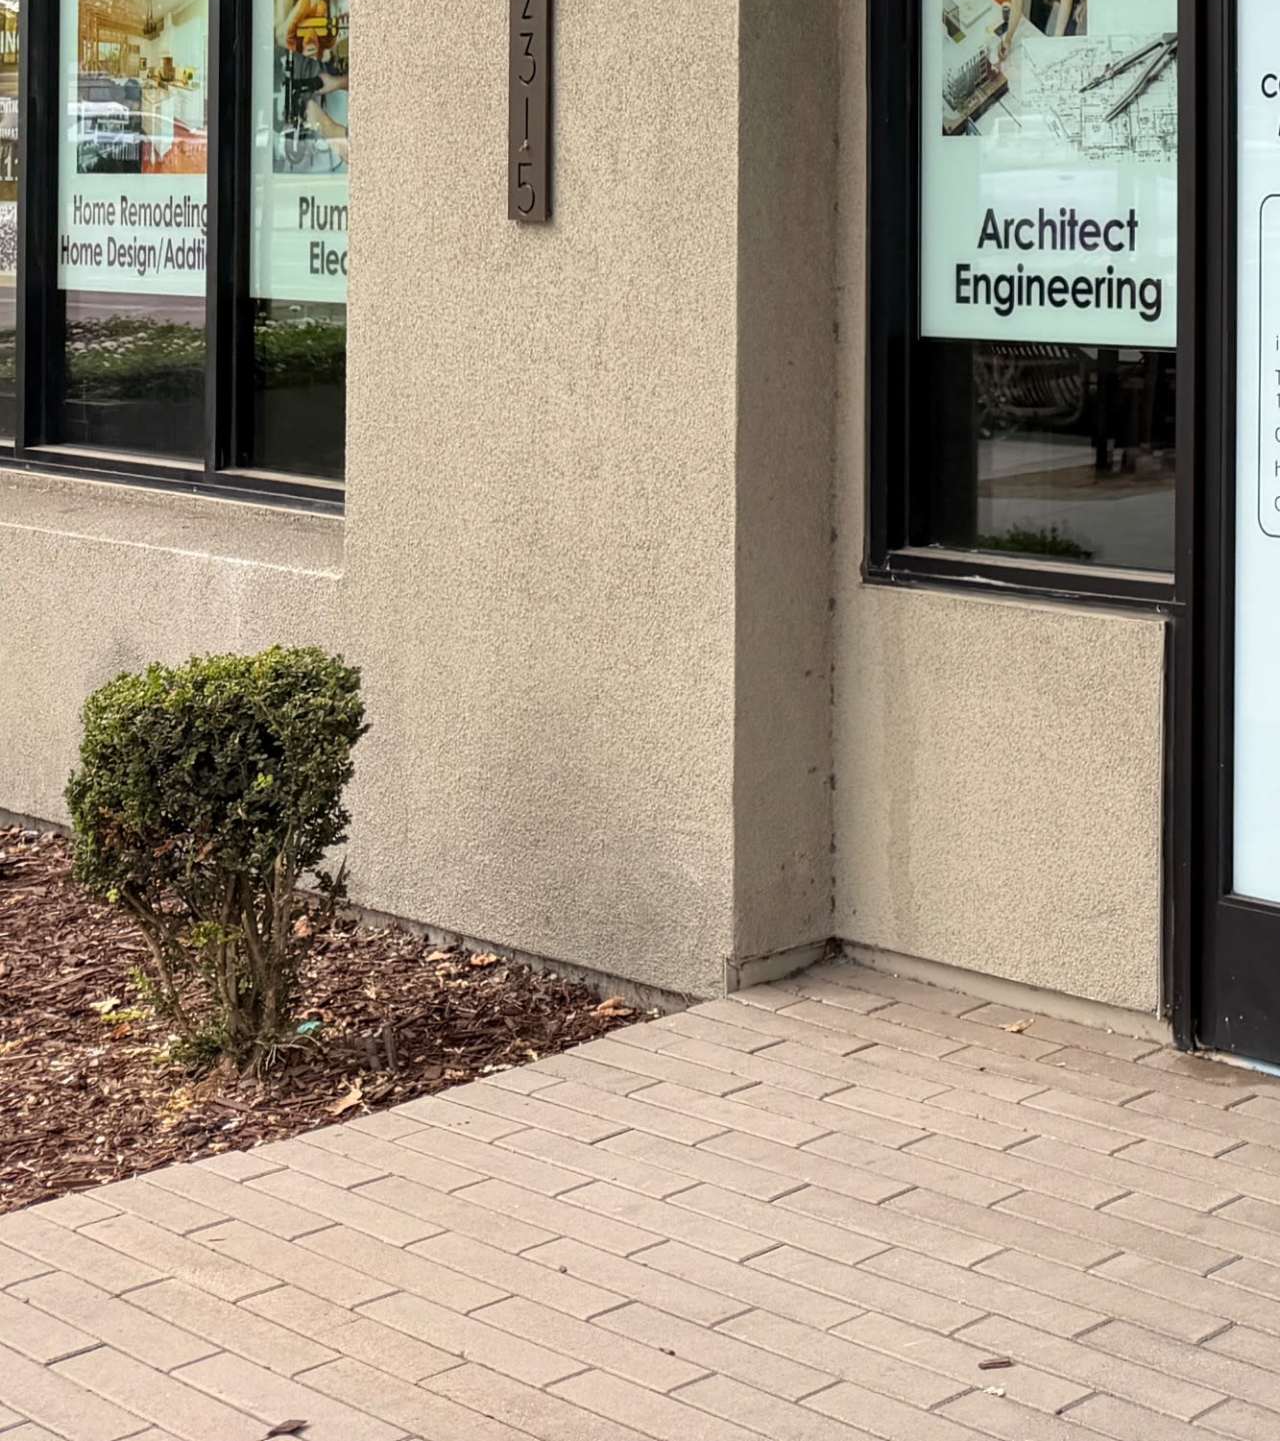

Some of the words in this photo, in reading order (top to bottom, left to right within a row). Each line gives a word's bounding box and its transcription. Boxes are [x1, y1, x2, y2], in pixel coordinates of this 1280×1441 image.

[74, 195, 115, 225] Home
[977, 208, 1138, 251] Architect
[60, 235, 102, 265] Home
[108, 238, 207, 274] Design/Addti
[956, 264, 1161, 321] Engineering
